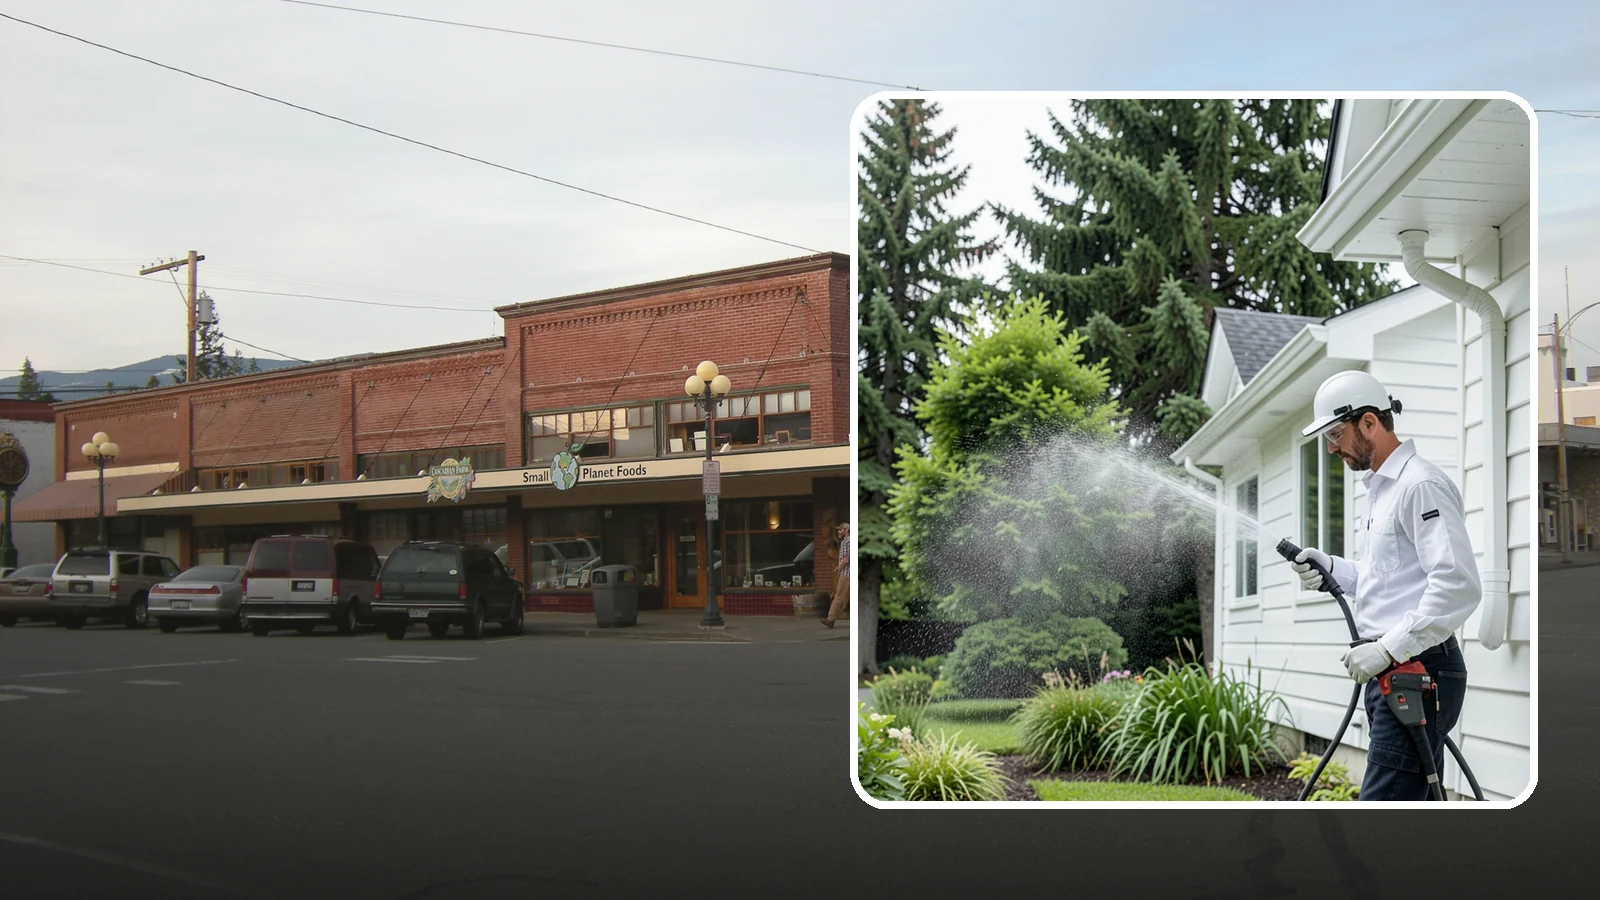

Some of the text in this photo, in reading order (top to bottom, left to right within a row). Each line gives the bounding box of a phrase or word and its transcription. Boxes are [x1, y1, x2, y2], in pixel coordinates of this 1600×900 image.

[523, 464, 647, 483] Small Planet Foods
